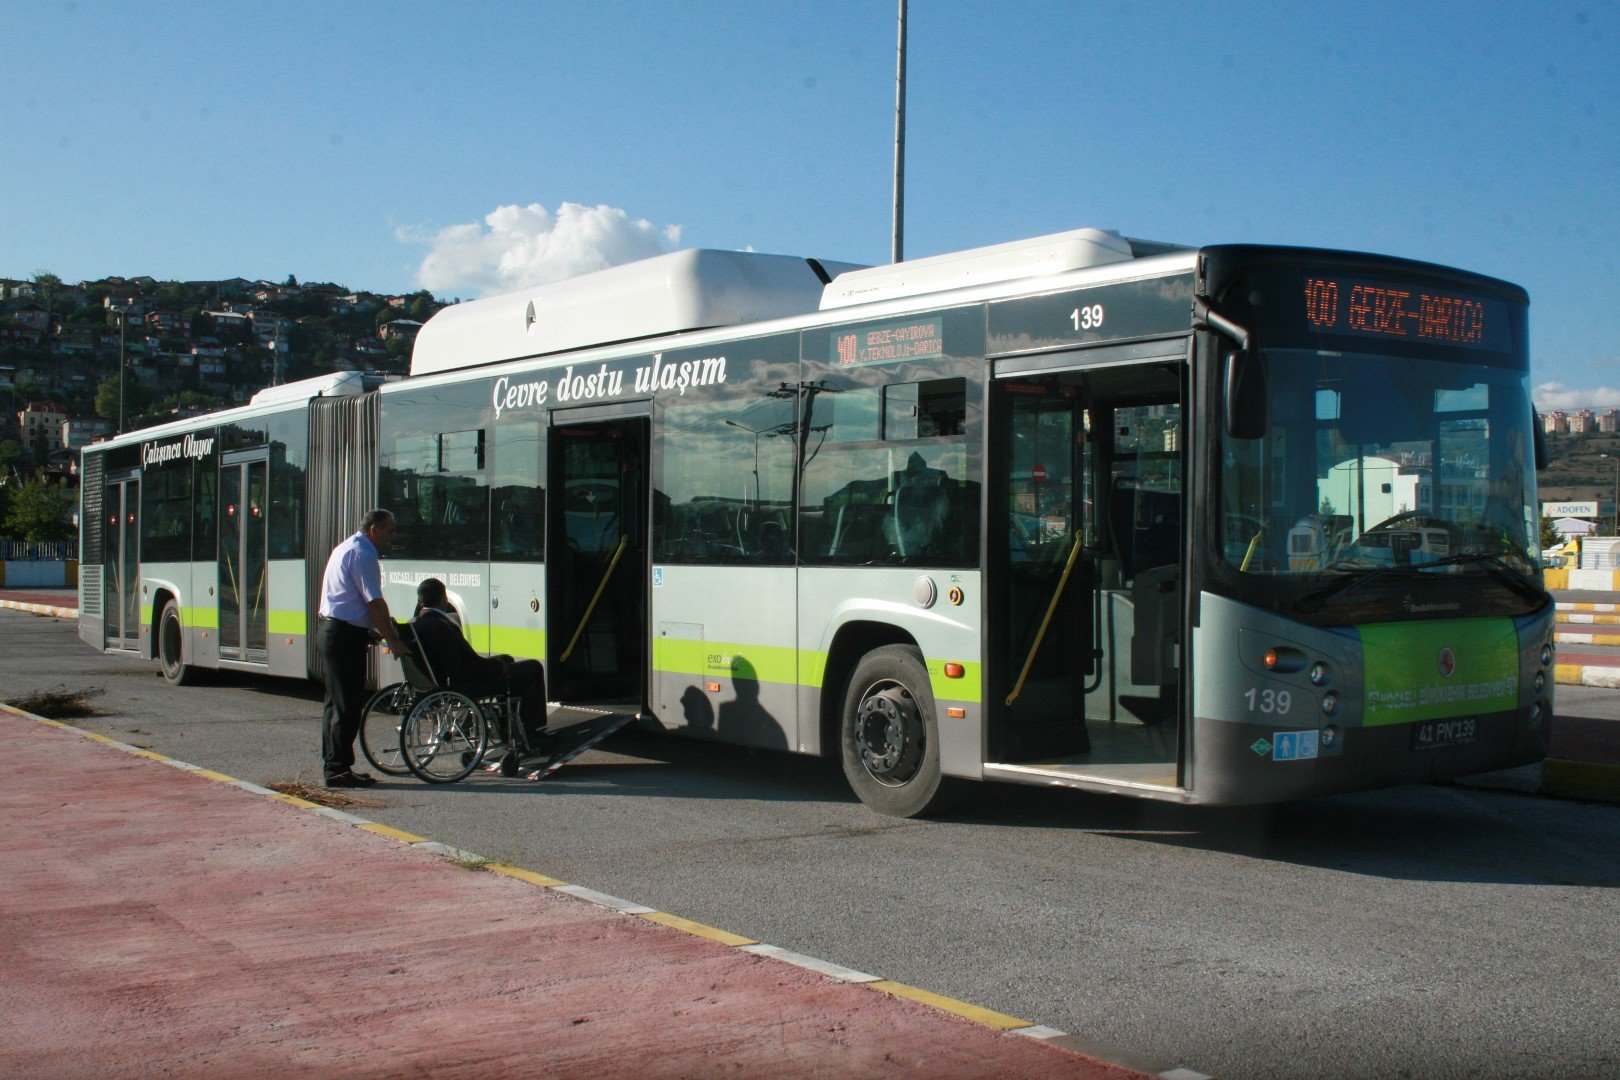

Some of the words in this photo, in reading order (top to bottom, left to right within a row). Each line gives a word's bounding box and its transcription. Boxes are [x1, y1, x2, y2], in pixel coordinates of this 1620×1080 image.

[1070, 304, 1104, 331] 139
[837, 334, 857, 365] 400
[492, 376, 548, 420] Çevre
[557, 365, 623, 402] dostu
[634, 353, 727, 395] ulaşım
[142, 440, 182, 471] Çalışınca
[183, 433, 215, 461] Oluyor
[1556, 505, 1591, 514] ADOPEN
[1244, 687, 1292, 716] 139
[1418, 723, 1434, 743] 41
[1455, 718, 1476, 738] 139
